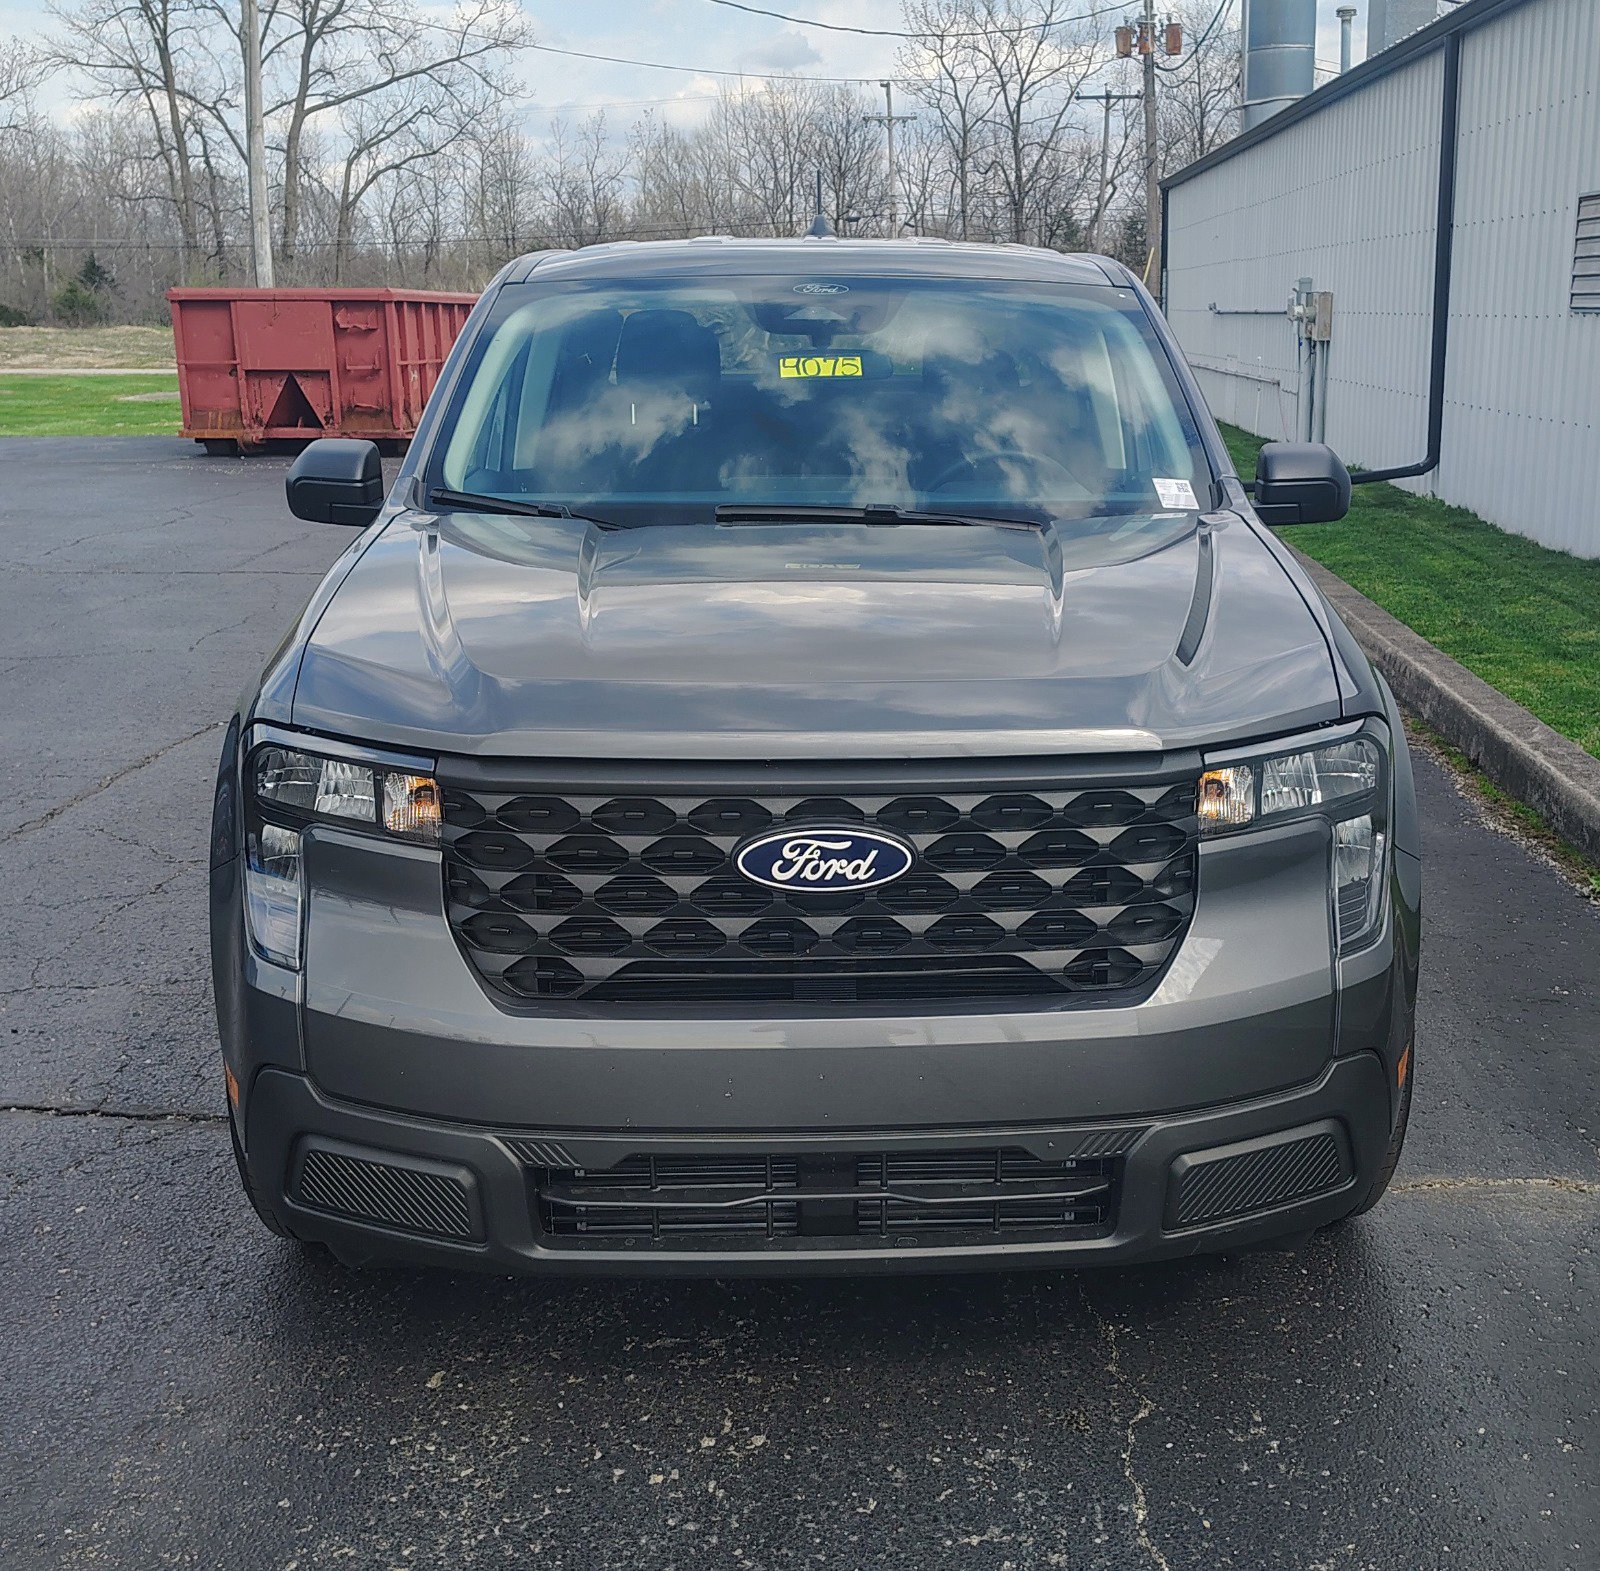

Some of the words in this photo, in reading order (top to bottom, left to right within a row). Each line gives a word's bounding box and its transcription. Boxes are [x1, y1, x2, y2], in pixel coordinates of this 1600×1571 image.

[803, 283, 839, 293] Ford
[782, 357, 860, 376] 4075
[771, 839, 879, 881] Ford
